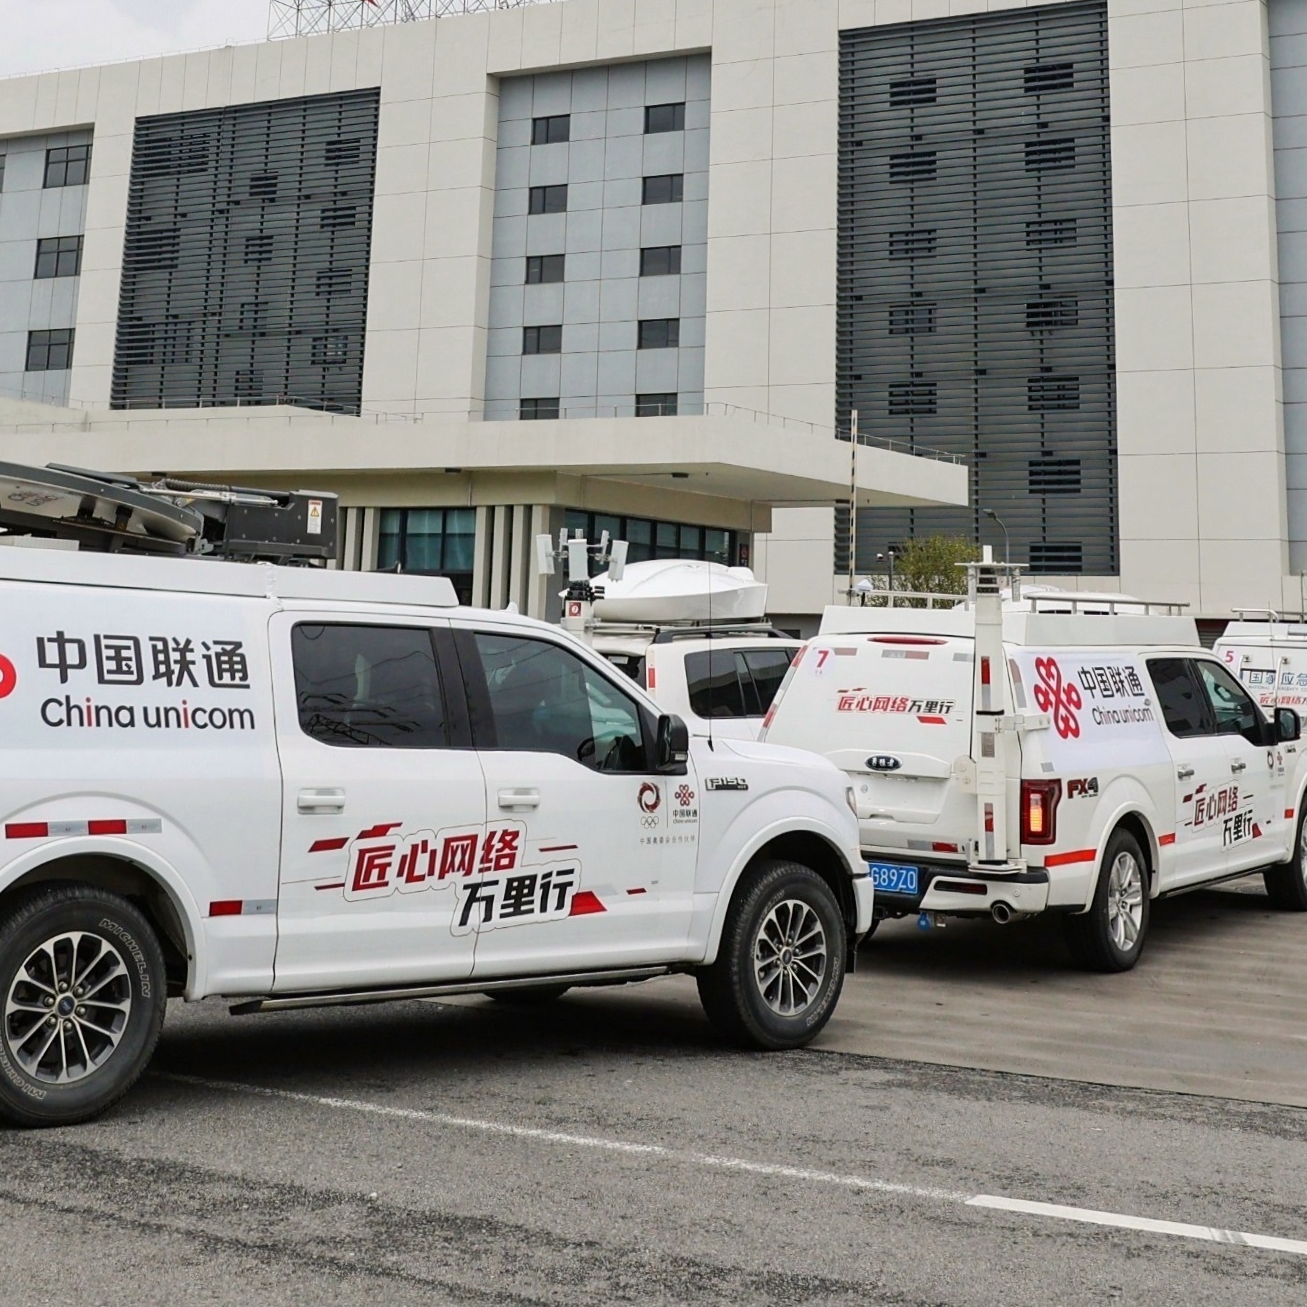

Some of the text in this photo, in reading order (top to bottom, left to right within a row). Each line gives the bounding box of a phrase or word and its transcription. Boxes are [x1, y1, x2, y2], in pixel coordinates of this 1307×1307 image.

[36, 630, 251, 690] 中国联通
[816, 650, 830, 668] 7
[1225, 650, 1234, 663] 5
[1077, 666, 1145, 699] 中国联通
[41, 695, 255, 730] China unicom
[837, 696, 955, 715] 匠心网络万里行
[1092, 705, 1155, 725] China unicom
[1066, 777, 1099, 799] FX4
[673, 809, 698, 818] 中国联通
[1194, 786, 1238, 827] 匠心网络
[1223, 809, 1253, 846] 万里行
[351, 829, 520, 892] 匠心网络
[458, 868, 576, 927] 万里行
[99, 918, 151, 998] MICHELIN
